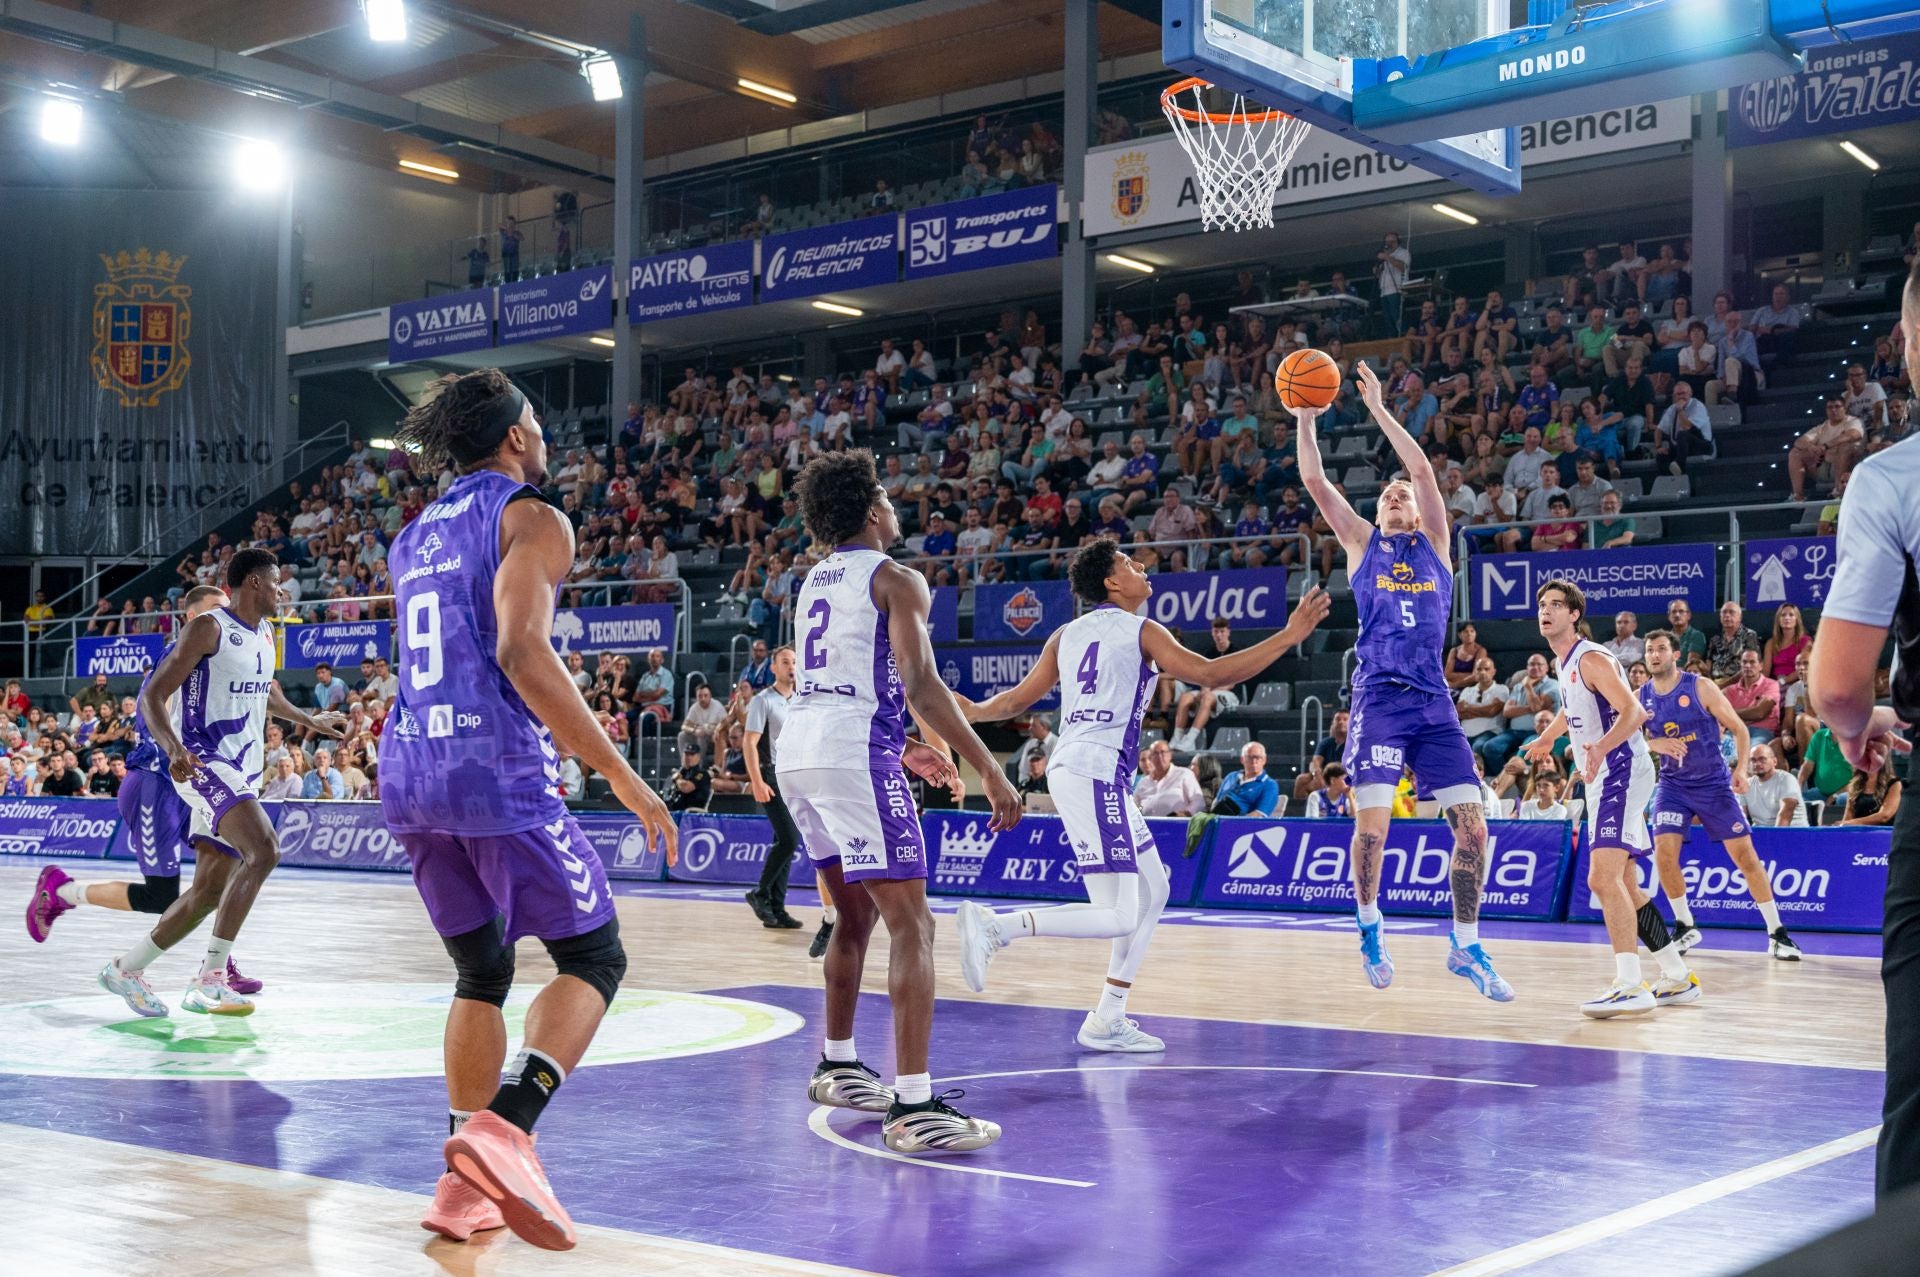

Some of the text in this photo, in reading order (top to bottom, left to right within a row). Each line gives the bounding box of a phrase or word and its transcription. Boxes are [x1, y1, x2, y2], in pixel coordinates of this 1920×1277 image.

[1499, 45, 1586, 82] MONDO
[1803, 48, 1889, 74] Loterías
[955, 205, 1048, 230] Transportes
[792, 234, 894, 264] NEUMÁTICOS
[951, 223, 1052, 256] BUJ
[785, 256, 864, 282] PALENCIA
[416, 302, 487, 331] VAYMA
[505, 300, 577, 326] Villanova
[638, 302, 683, 316] Transporte
[685, 296, 697, 309] de
[1, 429, 273, 468] Ayuntamiento
[20, 475, 249, 508] de Palencia
[436, 554, 461, 573] salud
[1537, 562, 1703, 584] MORALESCERVERA
[811, 567, 845, 587] HANNA
[1376, 579, 1437, 594] agropal
[1155, 575, 1270, 623] ovlac
[1610, 586, 1641, 598] Dental
[1643, 585, 1688, 596] Inmediata
[1400, 600, 1416, 628] 5
[323, 624, 377, 638] AMBULANCIAS
[406, 590, 444, 691] 9
[589, 618, 661, 643] TECNICAMPO
[805, 597, 831, 670] 2
[298, 626, 360, 667] Enrique
[88, 654, 153, 675] MUNDO
[256, 651, 263, 675] 1
[1076, 640, 1100, 695] 4
[457, 713, 482, 729] Dip
[1371, 744, 1403, 767] gaza
[211, 790, 226, 805] CBC
[48, 819, 117, 838] MODOS
[319, 811, 360, 828] súper
[1656, 811, 1684, 826] gaza
[1600, 826, 1617, 835] CBC
[896, 846, 918, 858] CBC
[1111, 847, 1131, 857] CBC
[1001, 858, 1055, 880] REY
[1681, 860, 1830, 898] épslon
[1221, 880, 1283, 895] cámaras
